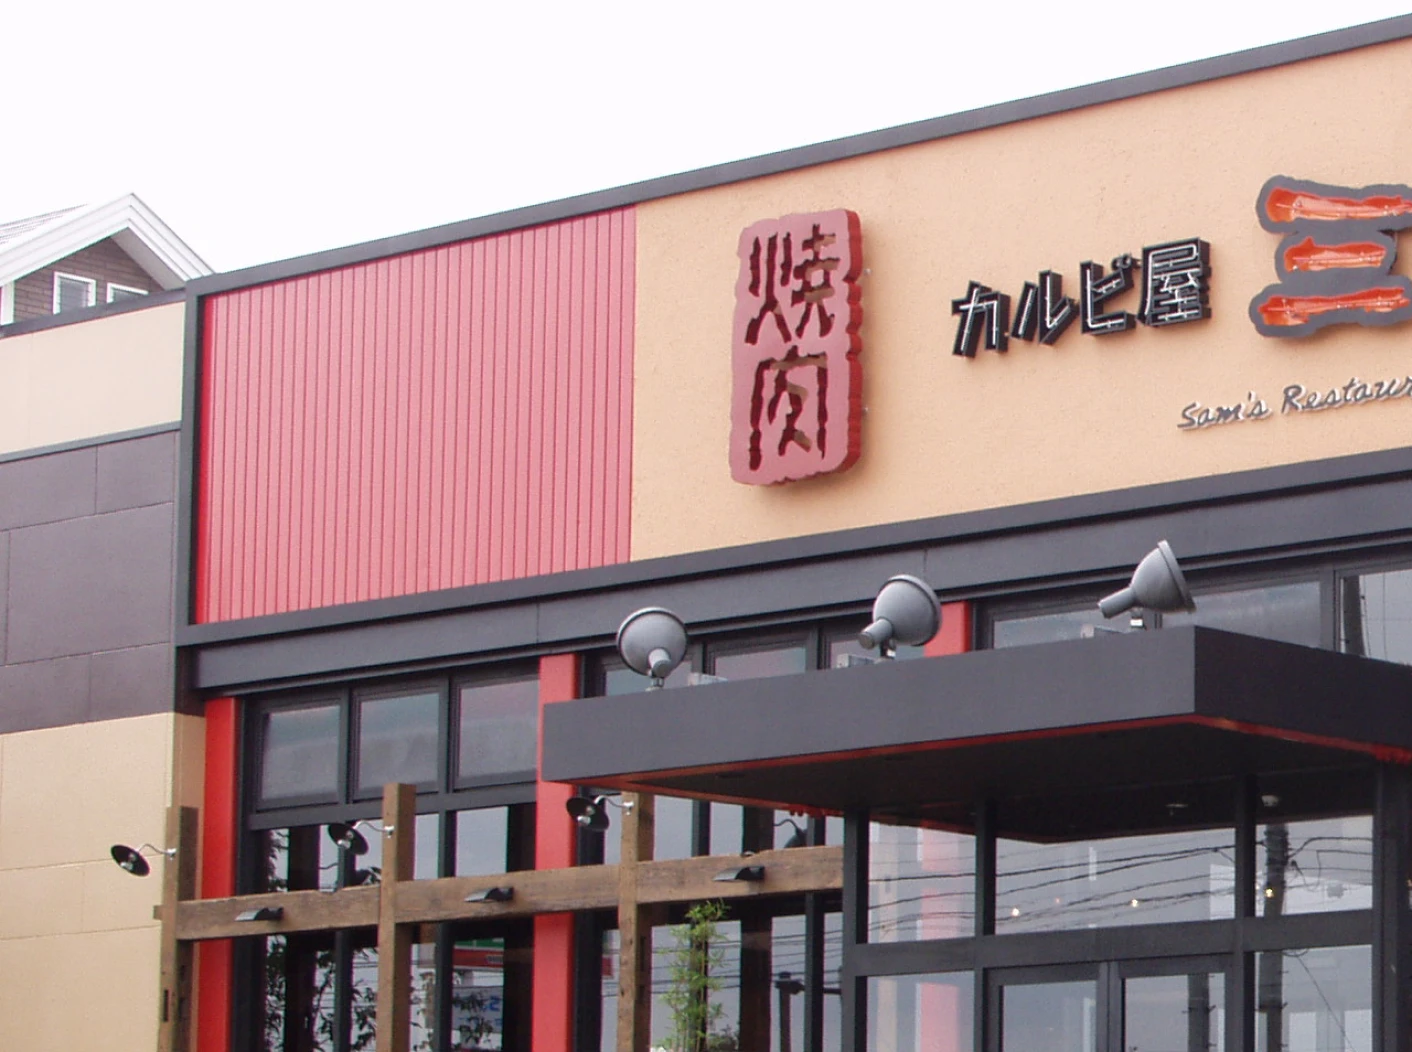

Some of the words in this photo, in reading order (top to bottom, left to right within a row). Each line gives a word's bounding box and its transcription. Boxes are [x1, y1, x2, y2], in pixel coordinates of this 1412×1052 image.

[744, 223, 841, 471] 焼肉
[951, 237, 1211, 358] カルビ屋
[1177, 391, 1270, 430] Sam's
